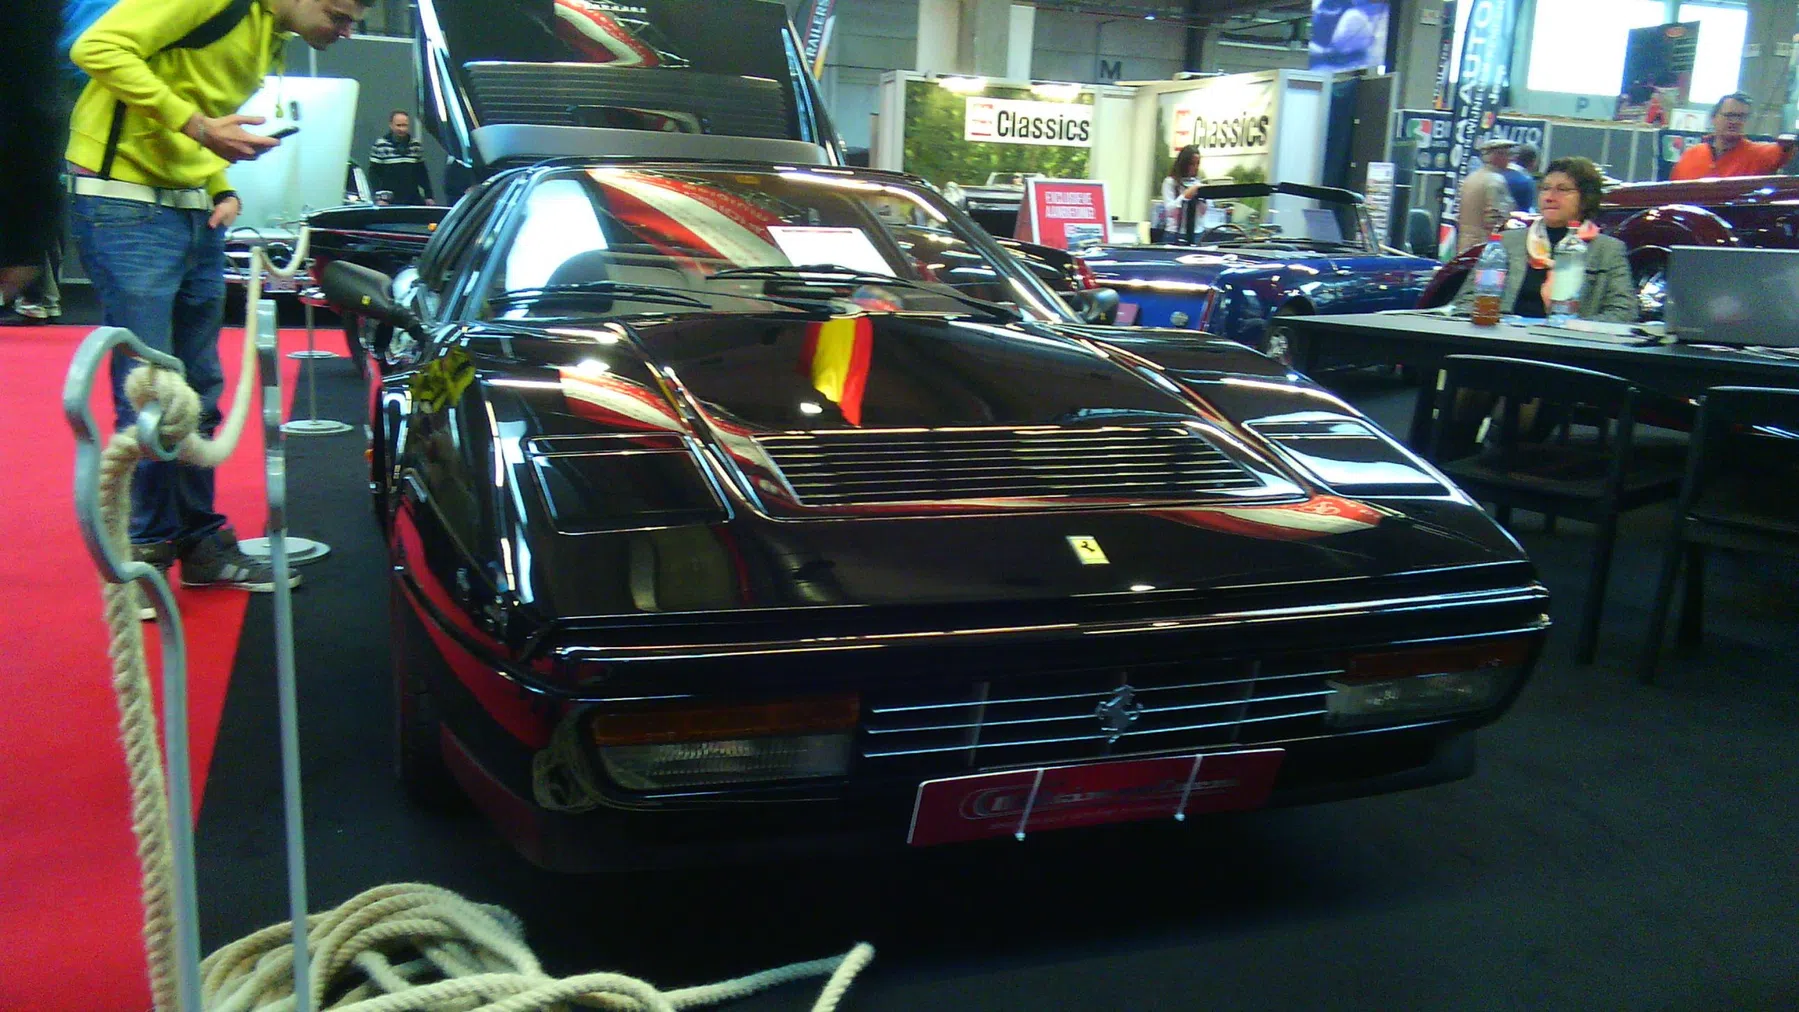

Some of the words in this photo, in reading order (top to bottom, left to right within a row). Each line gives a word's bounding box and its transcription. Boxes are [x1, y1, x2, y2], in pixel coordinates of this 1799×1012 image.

[1099, 59, 1122, 80] M
[997, 110, 1090, 142] Classics
[1192, 111, 1269, 149] Classics
